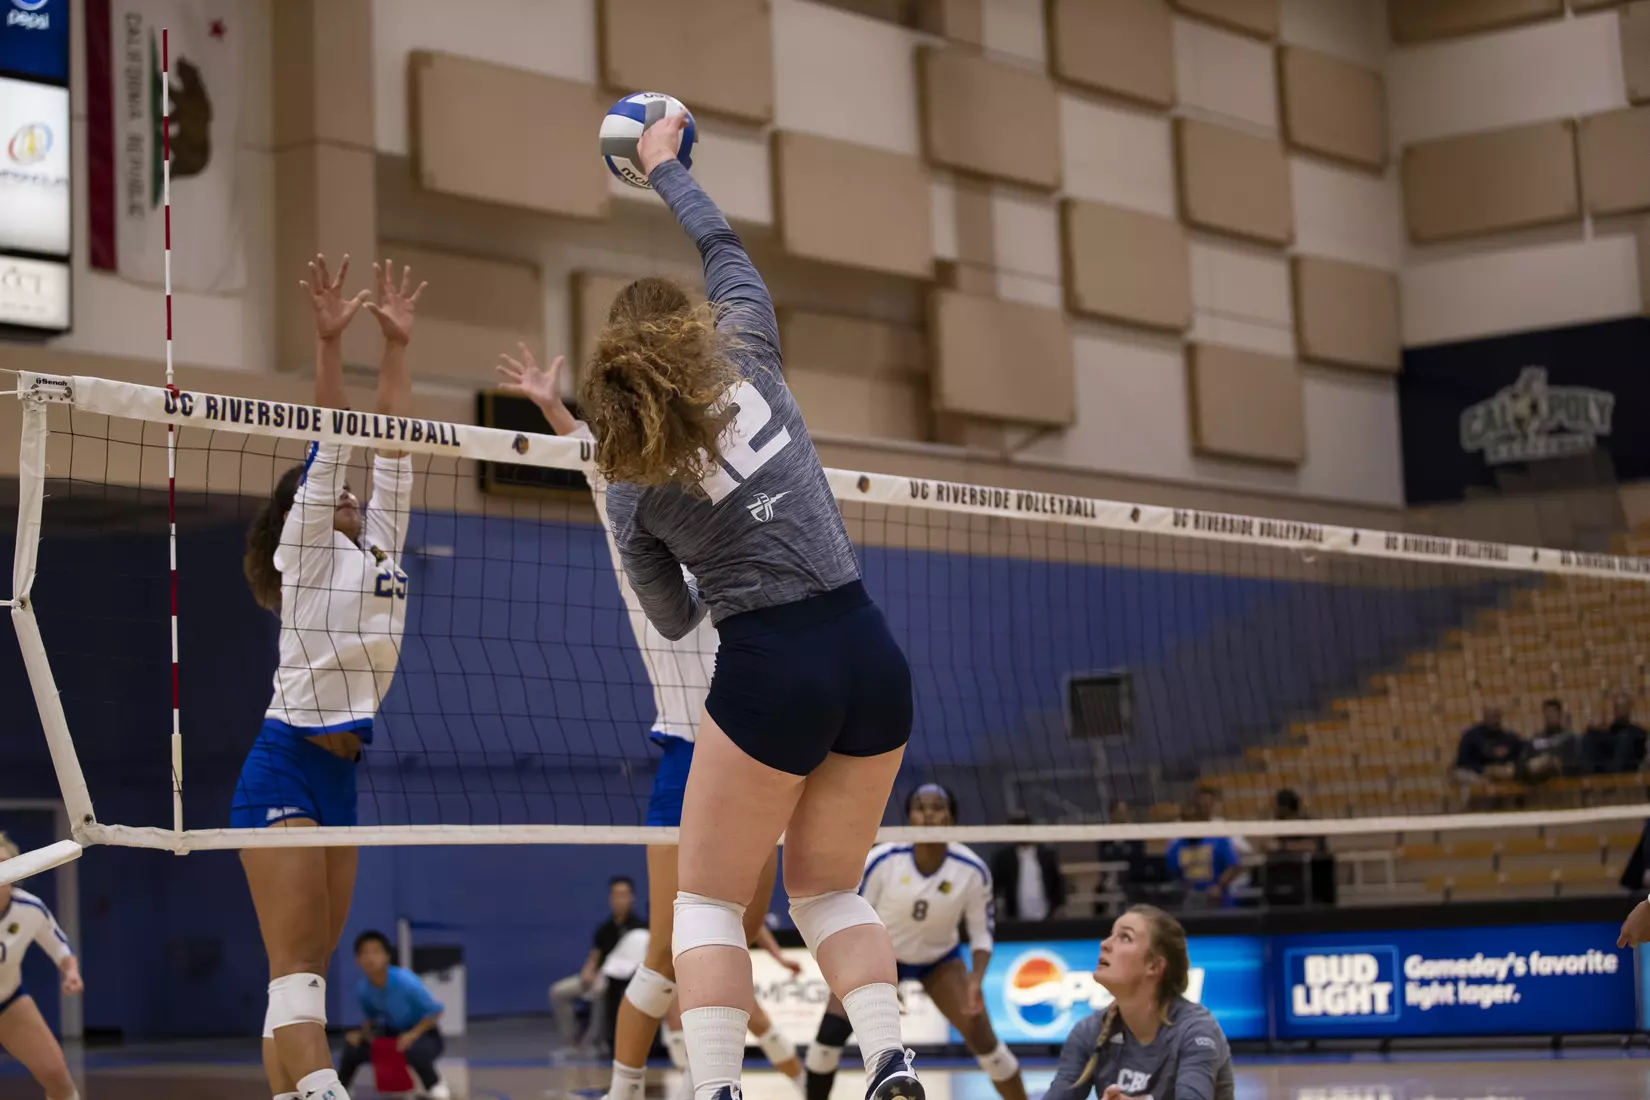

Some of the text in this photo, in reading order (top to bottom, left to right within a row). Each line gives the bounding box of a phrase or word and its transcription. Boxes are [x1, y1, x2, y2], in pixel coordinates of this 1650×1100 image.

[163, 390, 461, 447] UC RIVERSIDE VOLLEYBALL
[910, 480, 1097, 519] UC RIVERSIDE VOLLEYBALL
[911, 901, 930, 922] 8
[1303, 953, 1379, 984] BUD
[1404, 949, 1619, 981] Gameday's favorite
[1291, 982, 1393, 1016] LIGHT
[1405, 981, 1522, 1010] light lager.
